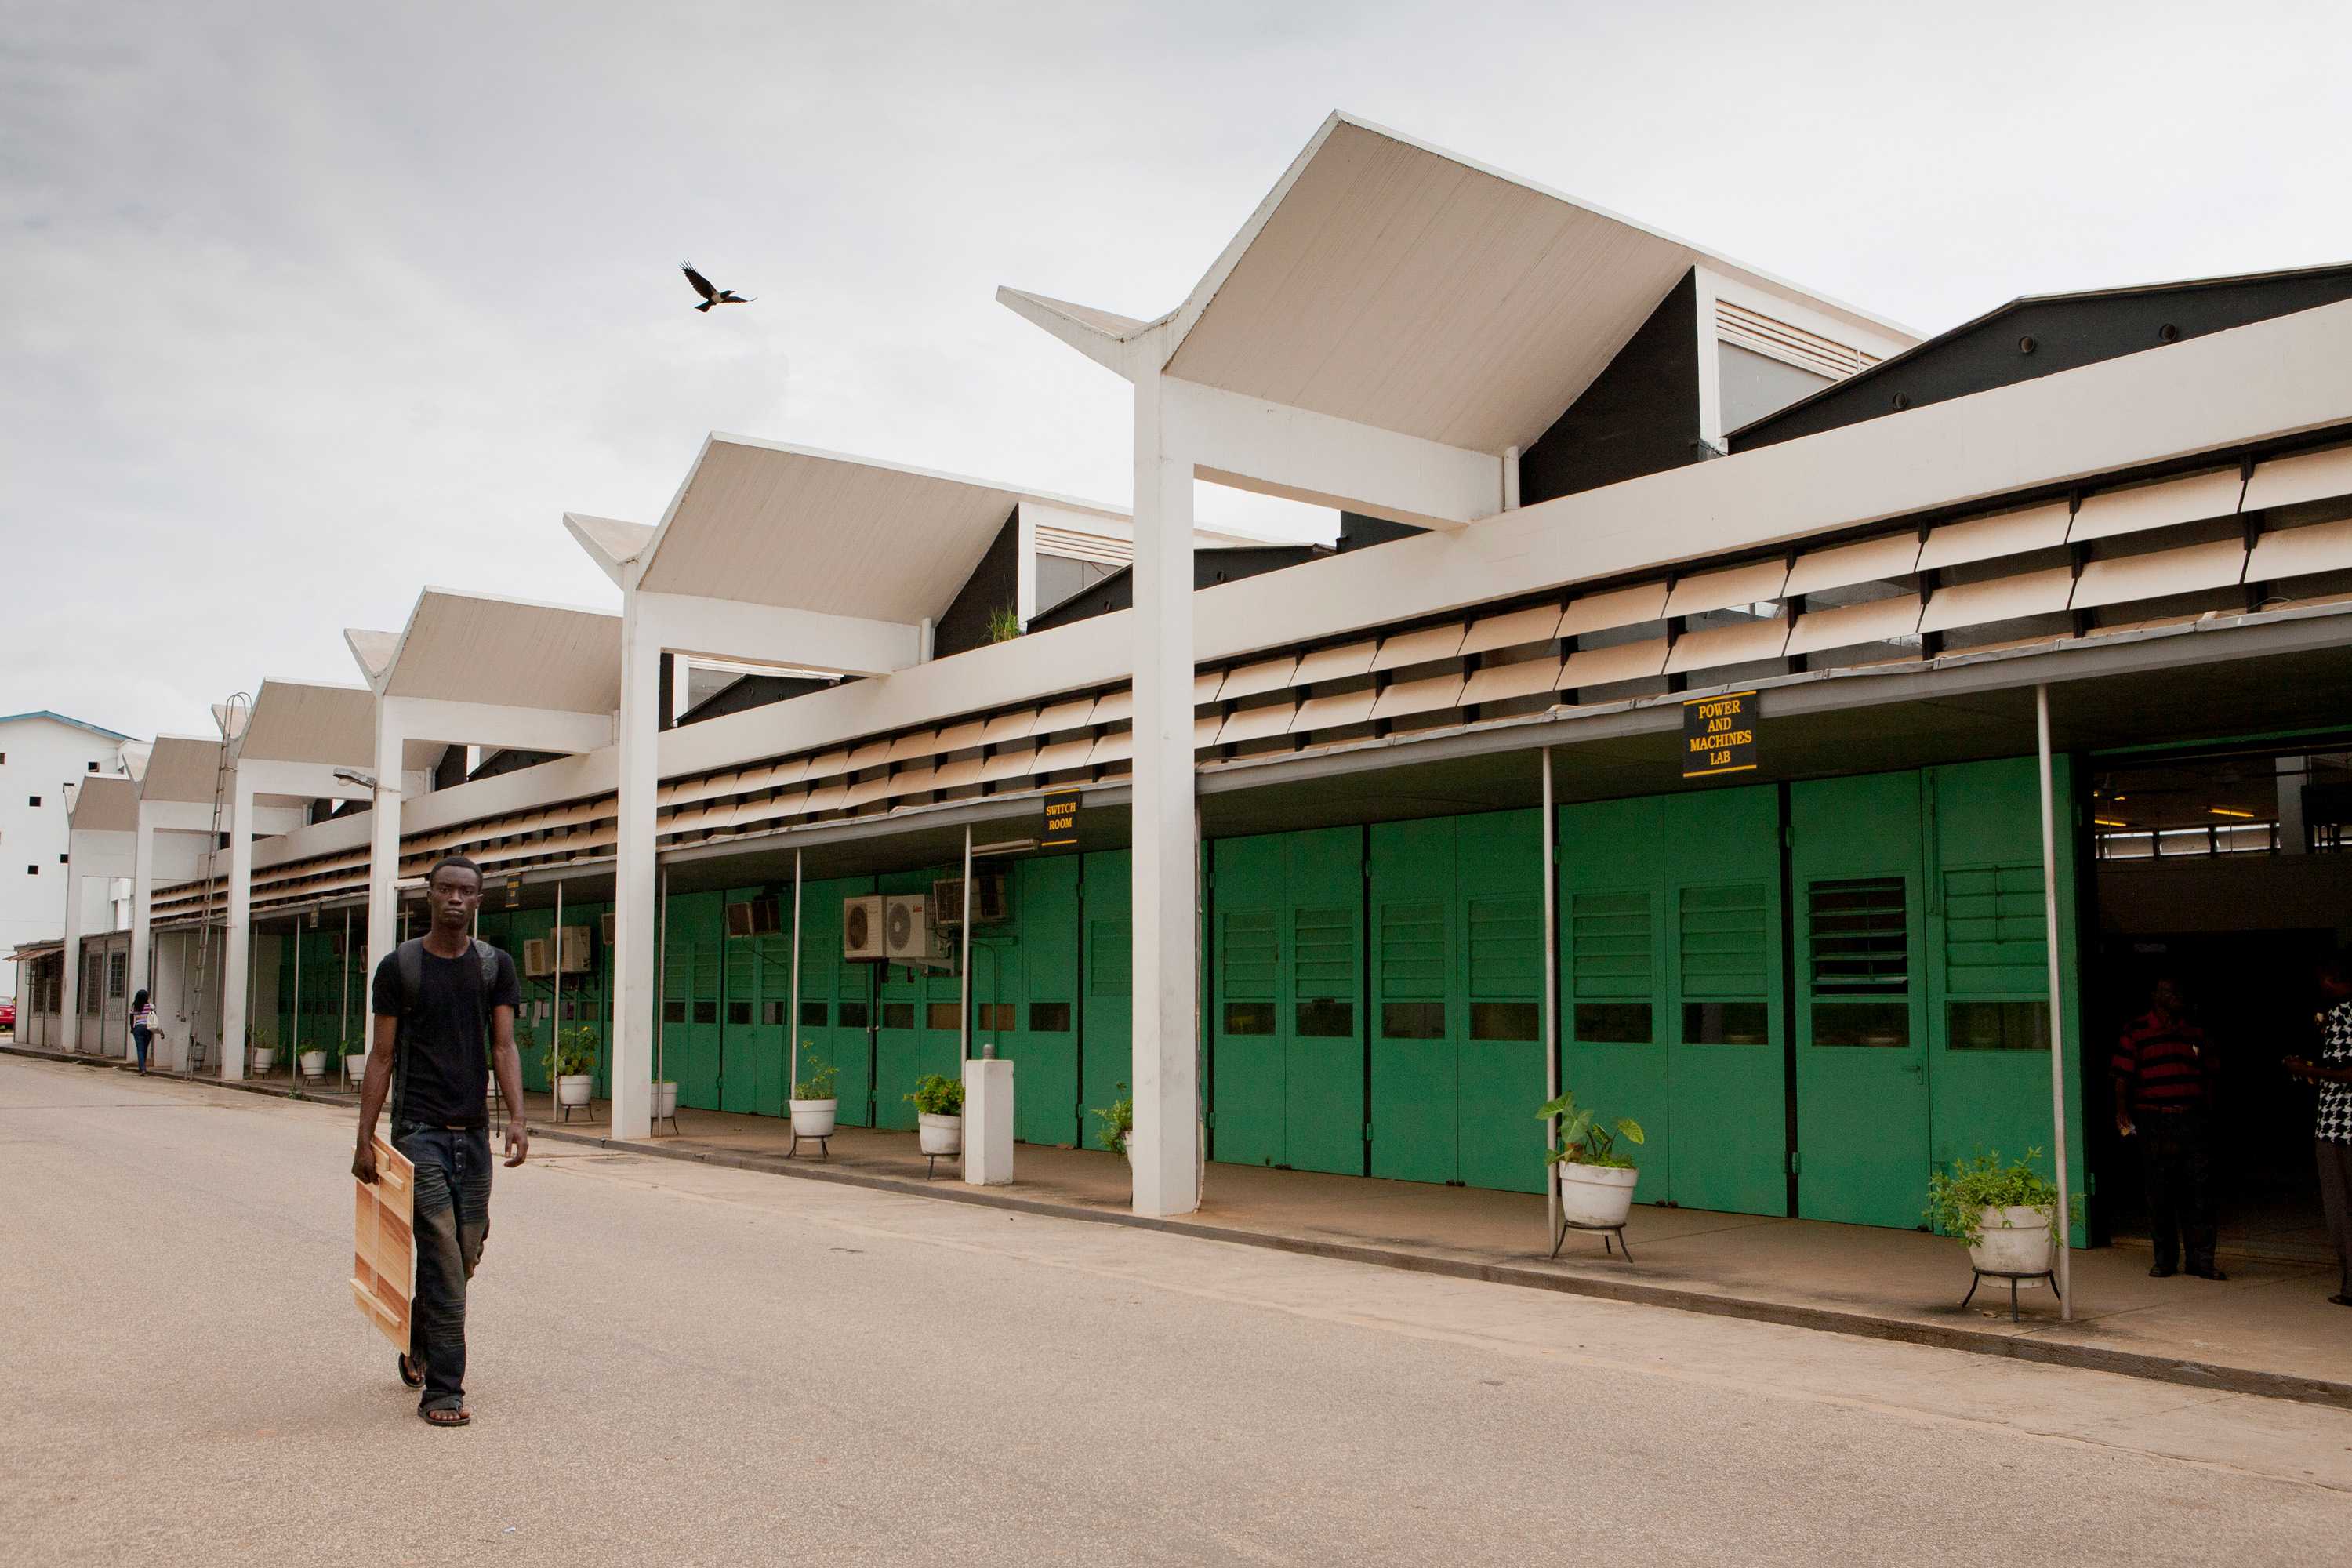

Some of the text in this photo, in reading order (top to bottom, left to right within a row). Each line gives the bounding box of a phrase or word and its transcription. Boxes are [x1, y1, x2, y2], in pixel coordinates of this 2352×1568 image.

[1699, 700, 1740, 719] POWER
[1707, 717, 1731, 732] AND
[1690, 730, 1751, 752] MACHINES
[1710, 750, 1730, 765] LAB
[1047, 802, 1076, 815] SWITCH
[1048, 817, 1072, 830] ROOM
